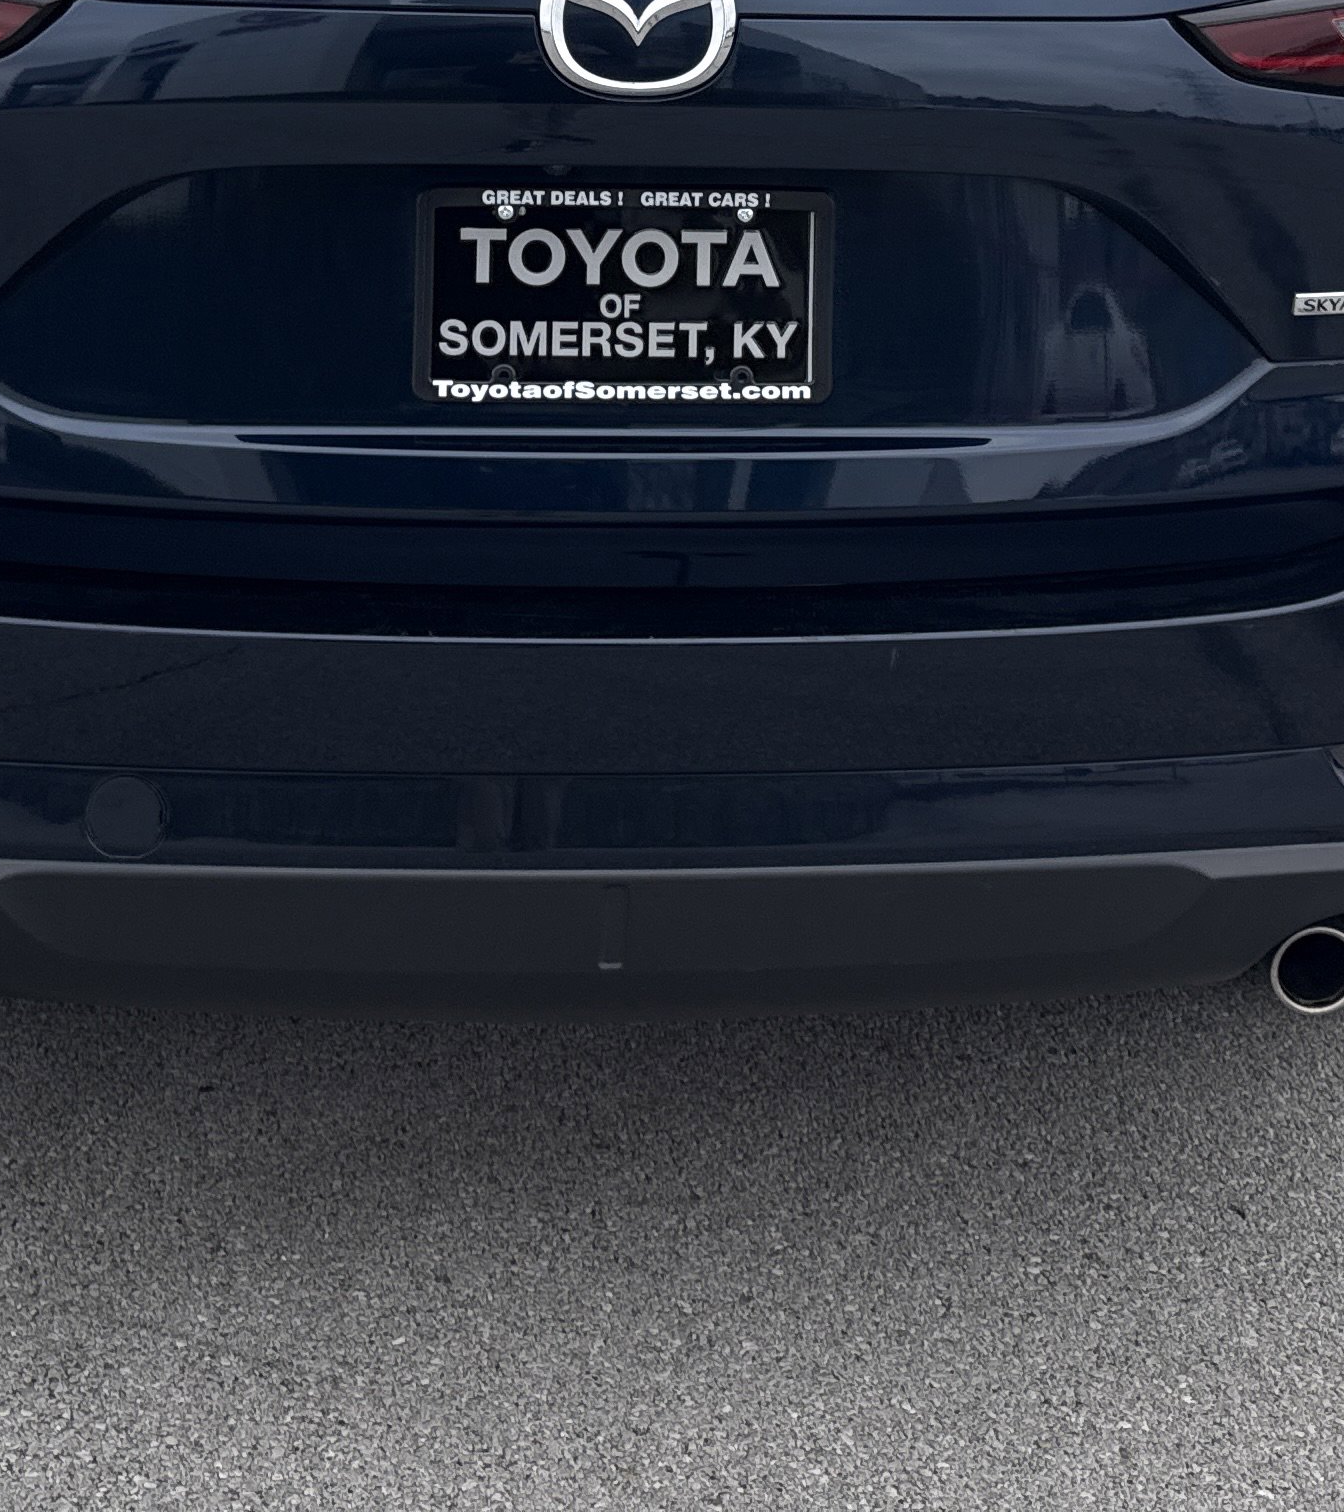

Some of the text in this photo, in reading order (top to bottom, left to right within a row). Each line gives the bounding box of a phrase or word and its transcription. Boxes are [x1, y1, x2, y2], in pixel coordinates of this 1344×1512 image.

[481, 190, 545, 207] GREAT
[640, 191, 704, 208] GREAT
[459, 227, 781, 289] TOYOTA
[599, 293, 642, 319] OF
[438, 319, 799, 366] SOMERSET, KY
[431, 378, 812, 403] ToyotaofSomerset.com
